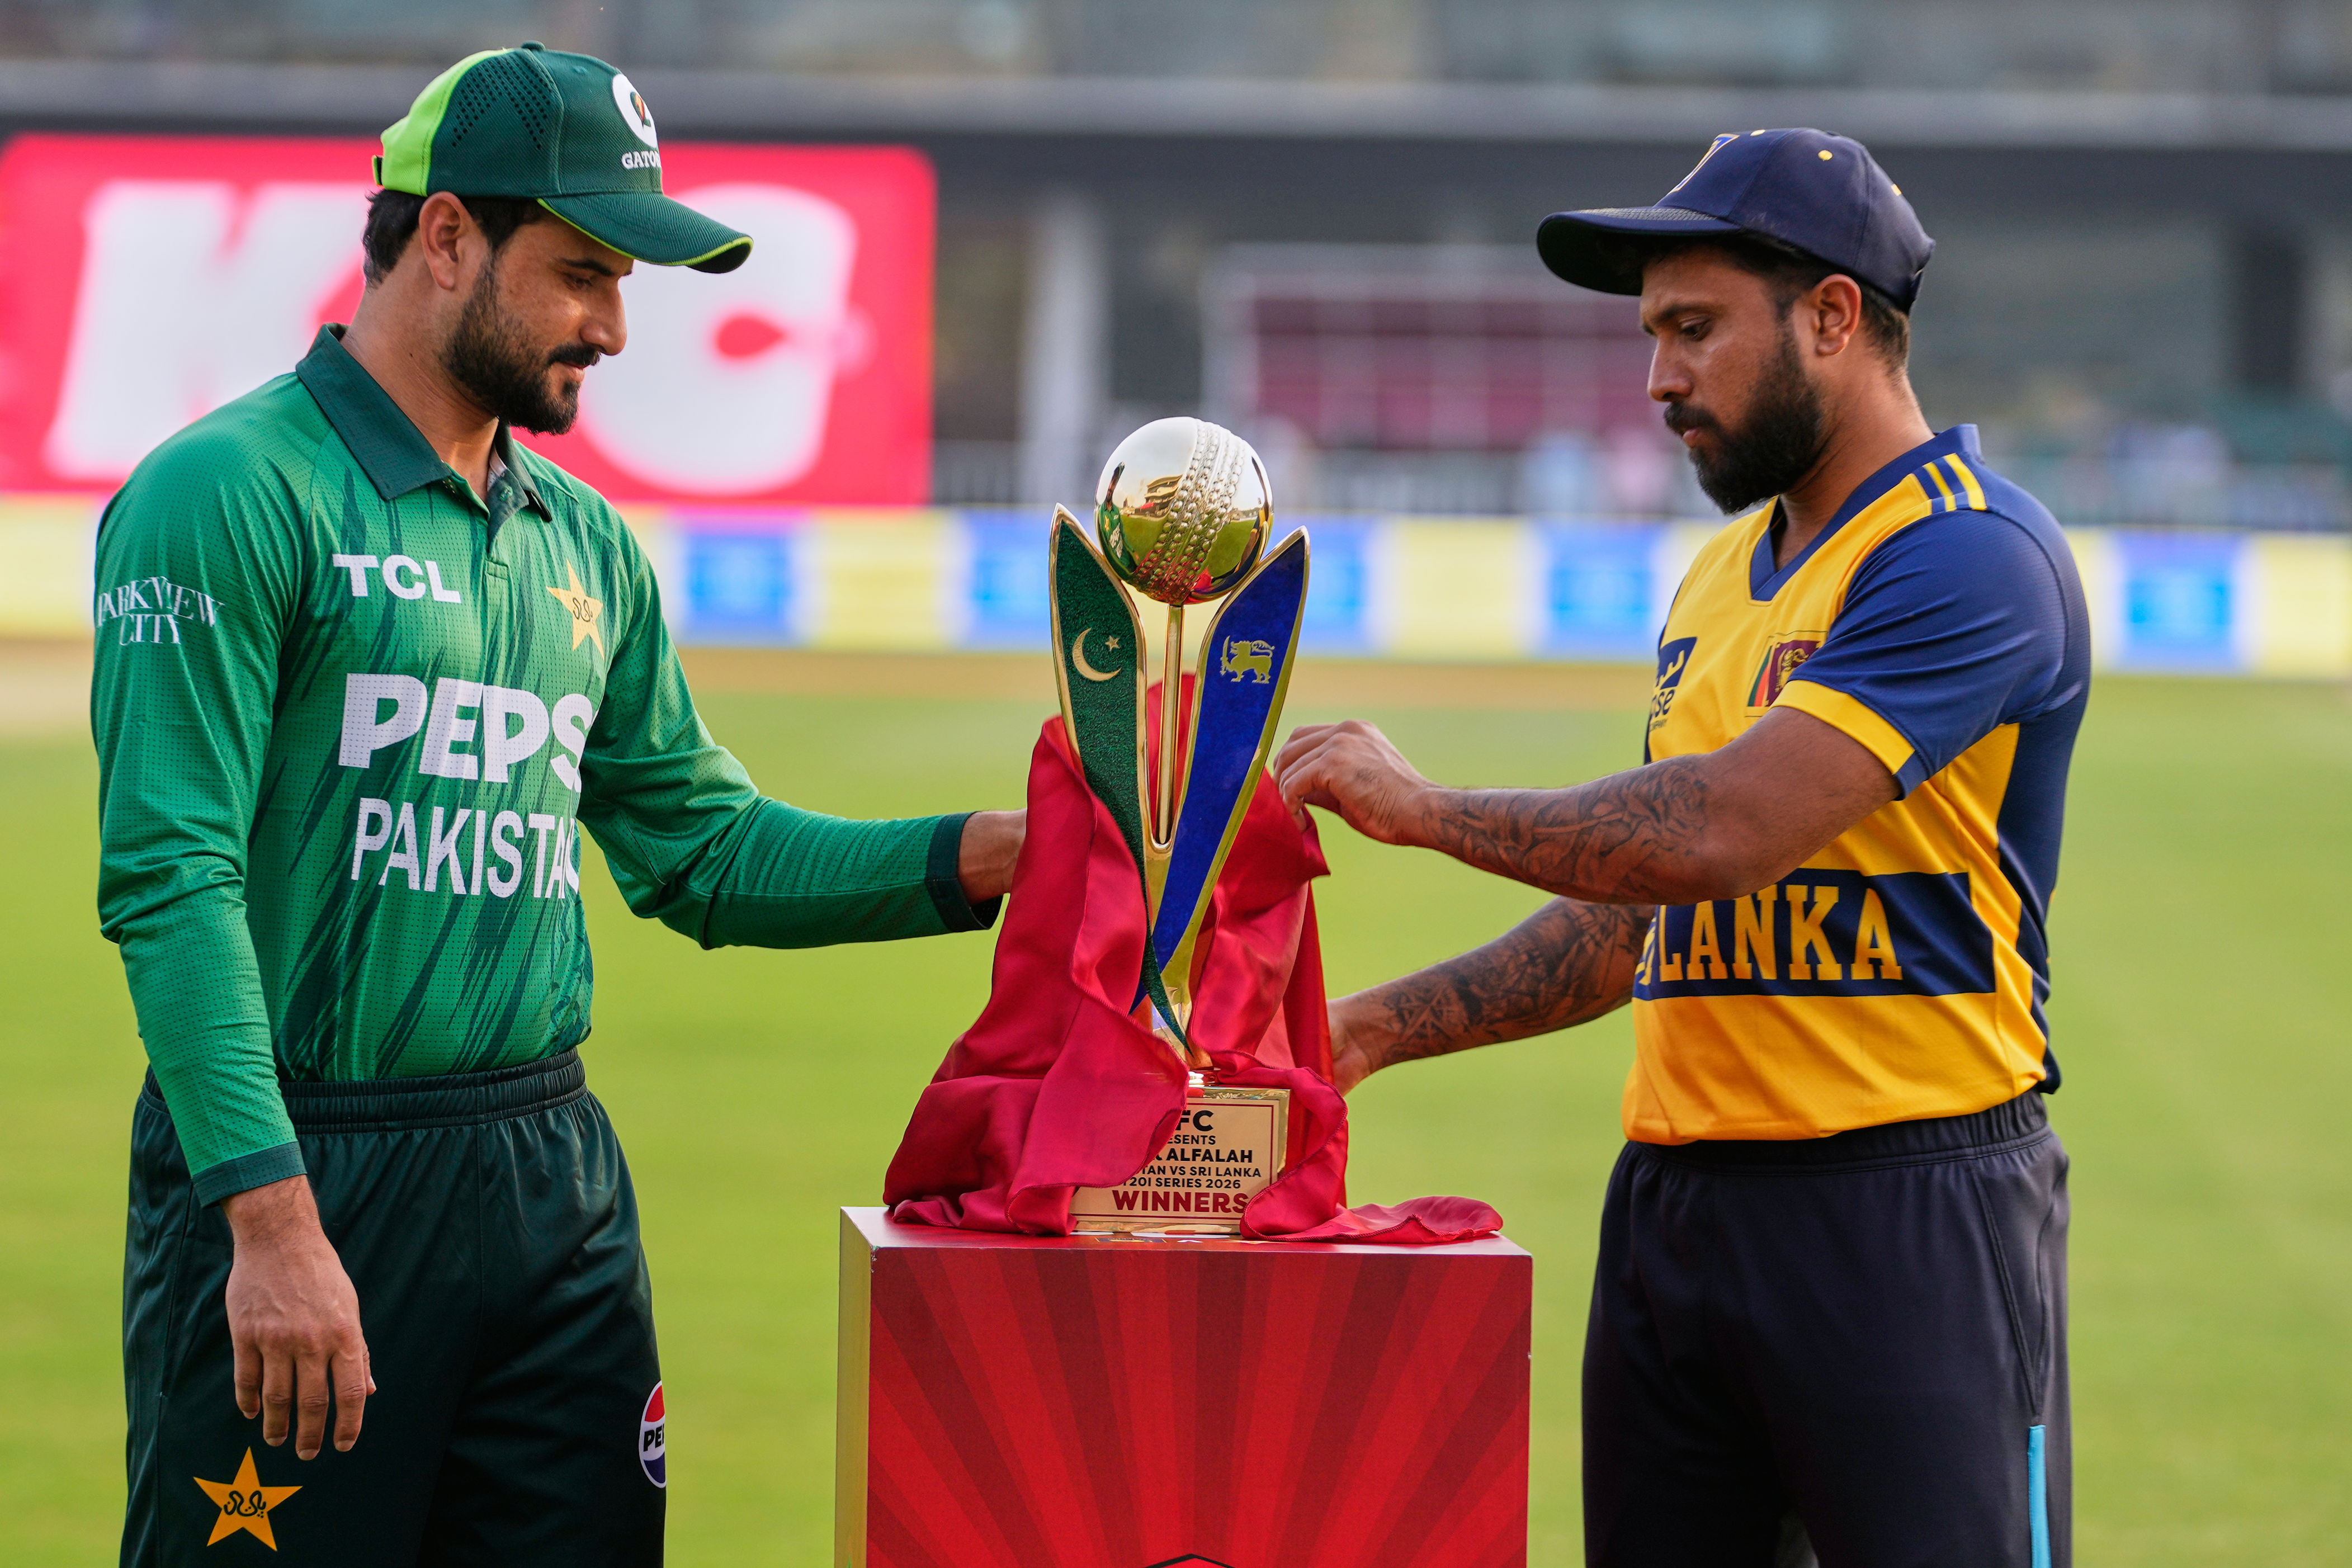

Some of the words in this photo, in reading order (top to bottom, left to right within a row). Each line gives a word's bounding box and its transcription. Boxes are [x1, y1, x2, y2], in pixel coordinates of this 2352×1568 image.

[44, 180, 864, 495] KC
[332, 554, 461, 604] TCL
[119, 613, 181, 646] CITY
[338, 673, 596, 793] PEPS
[1658, 884, 1903, 983] LANKA
[1166, 1147, 1253, 1163] ALFALAH
[1170, 1165, 1186, 1175] VS
[1189, 1166, 1211, 1177] SRI
[1216, 1166, 1262, 1178] LANKA
[1155, 1178, 1202, 1188] SERIES
[1206, 1178, 1241, 1189] 2026
[1112, 1189, 1249, 1213] WINNERS
